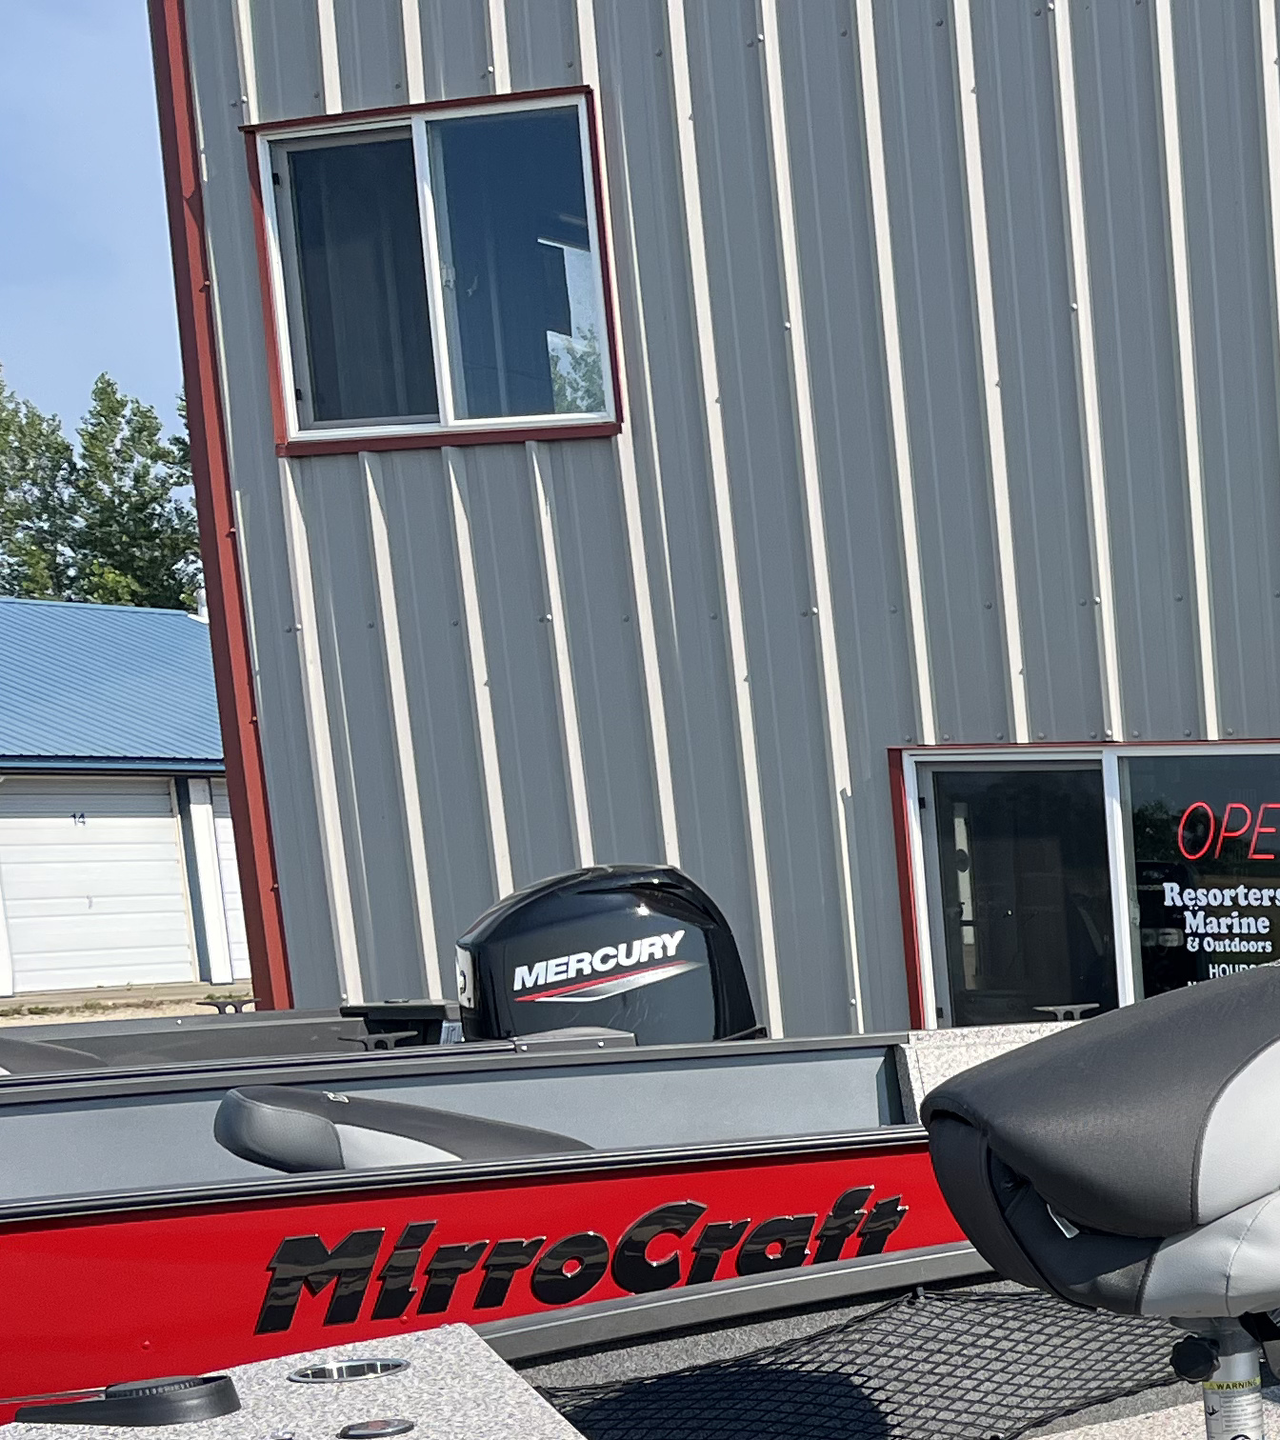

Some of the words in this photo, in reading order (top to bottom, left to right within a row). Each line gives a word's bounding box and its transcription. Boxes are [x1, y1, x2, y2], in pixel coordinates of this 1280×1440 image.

[1183, 910, 1270, 934] Marine
[1186, 936, 1200, 952] &
[1203, 936, 1272, 952] Outdoors
[512, 929, 686, 991] MERCURY
[255, 1184, 910, 1335] MirroCraft
[1215, 1378, 1257, 1390] WARNING
